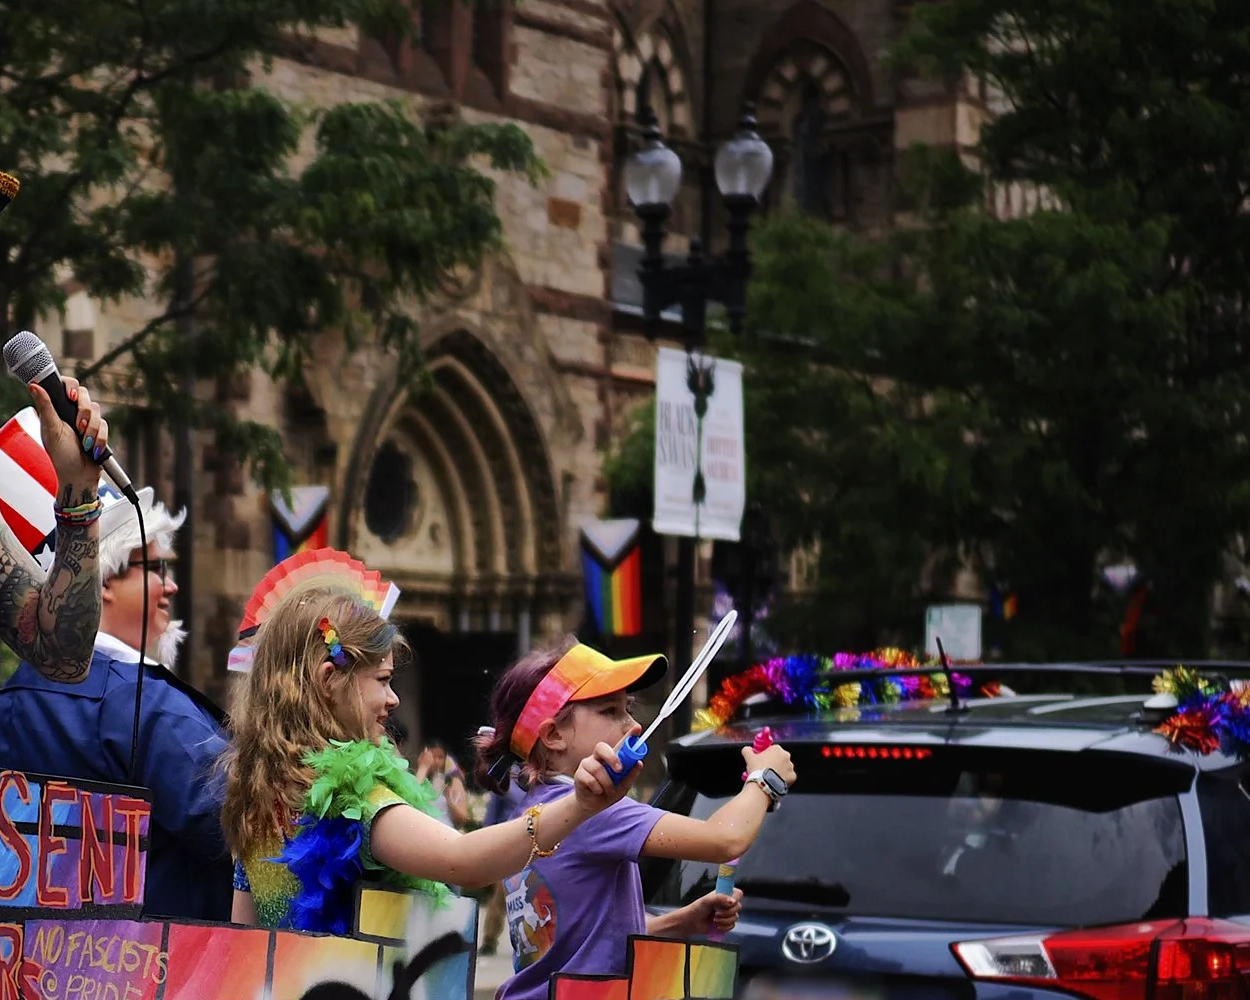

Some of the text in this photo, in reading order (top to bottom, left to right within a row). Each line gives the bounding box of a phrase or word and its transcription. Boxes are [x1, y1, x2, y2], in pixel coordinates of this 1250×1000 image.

[508, 896, 524, 915] MASS
[32, 926, 170, 985] NO FASCISTS
[40, 969, 59, 1000] @
